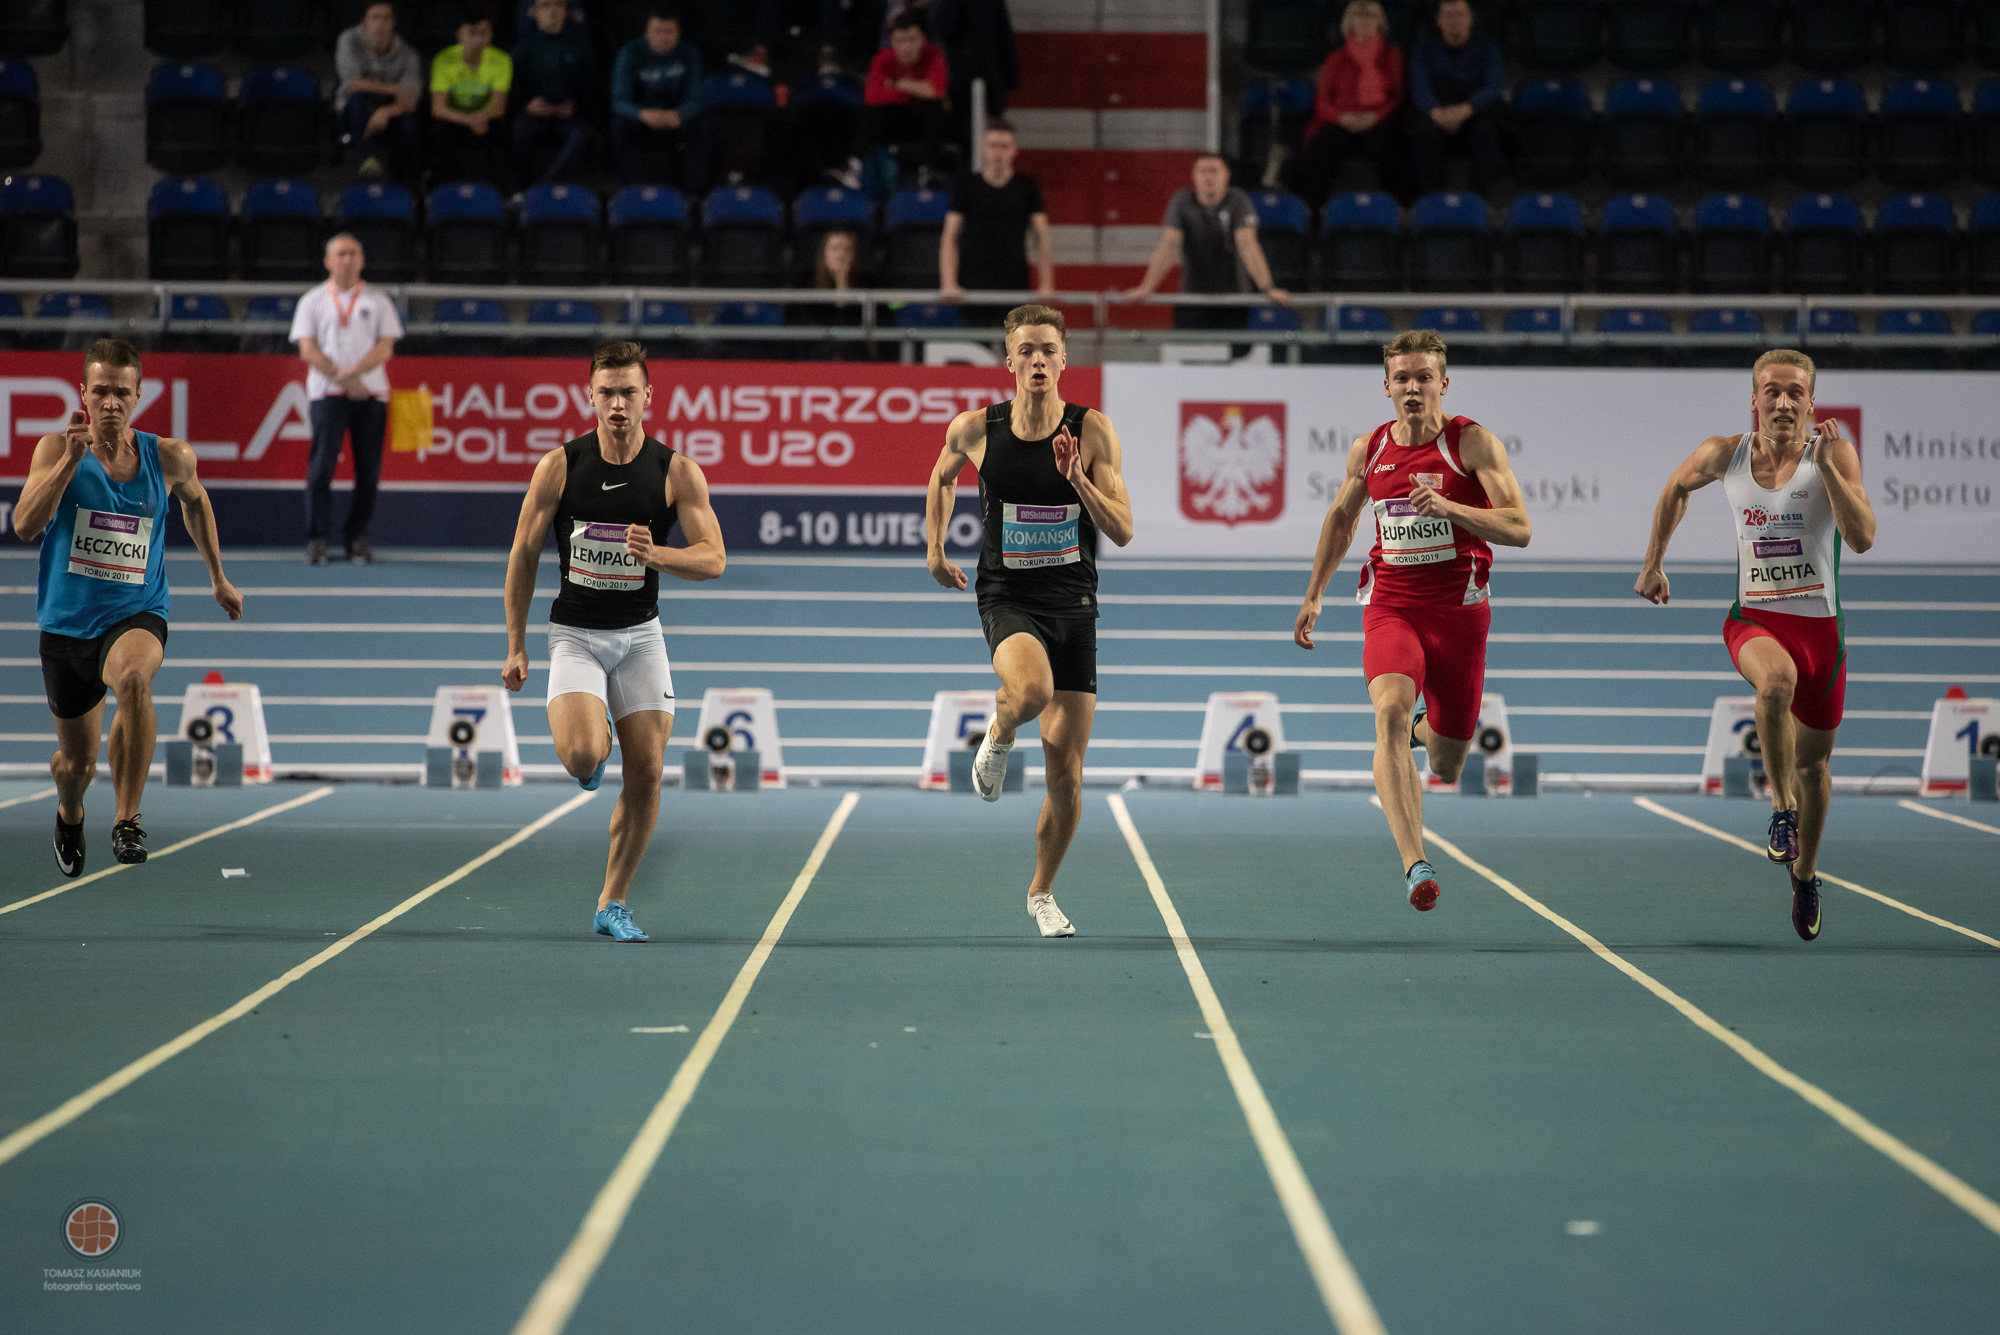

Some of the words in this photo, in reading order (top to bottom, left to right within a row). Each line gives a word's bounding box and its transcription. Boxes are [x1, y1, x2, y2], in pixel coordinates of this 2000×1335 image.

[741, 430, 855, 467] U20
[1884, 477, 1990, 514] Sportu
[1792, 513, 1803, 521] SSE
[588, 527, 628, 540] noskiewic
[758, 510, 840, 546] 8-10
[1005, 526, 1075, 545] KOMAŃSKI
[1383, 521, 1449, 540] ŁUPIŃSKI
[75, 535, 146, 560] ŁĘCZYCKI
[1019, 556, 1045, 567] TORUŃ
[1047, 557, 1065, 565] 2019
[1394, 554, 1420, 563] TORUŃ
[1421, 553, 1439, 562] 2019
[84, 567, 110, 578] TORUŃ
[112, 572, 130, 581] 2019
[1751, 563, 1816, 582] PLICHTA
[583, 577, 607, 588] TORUŃ
[610, 581, 628, 589] 2019
